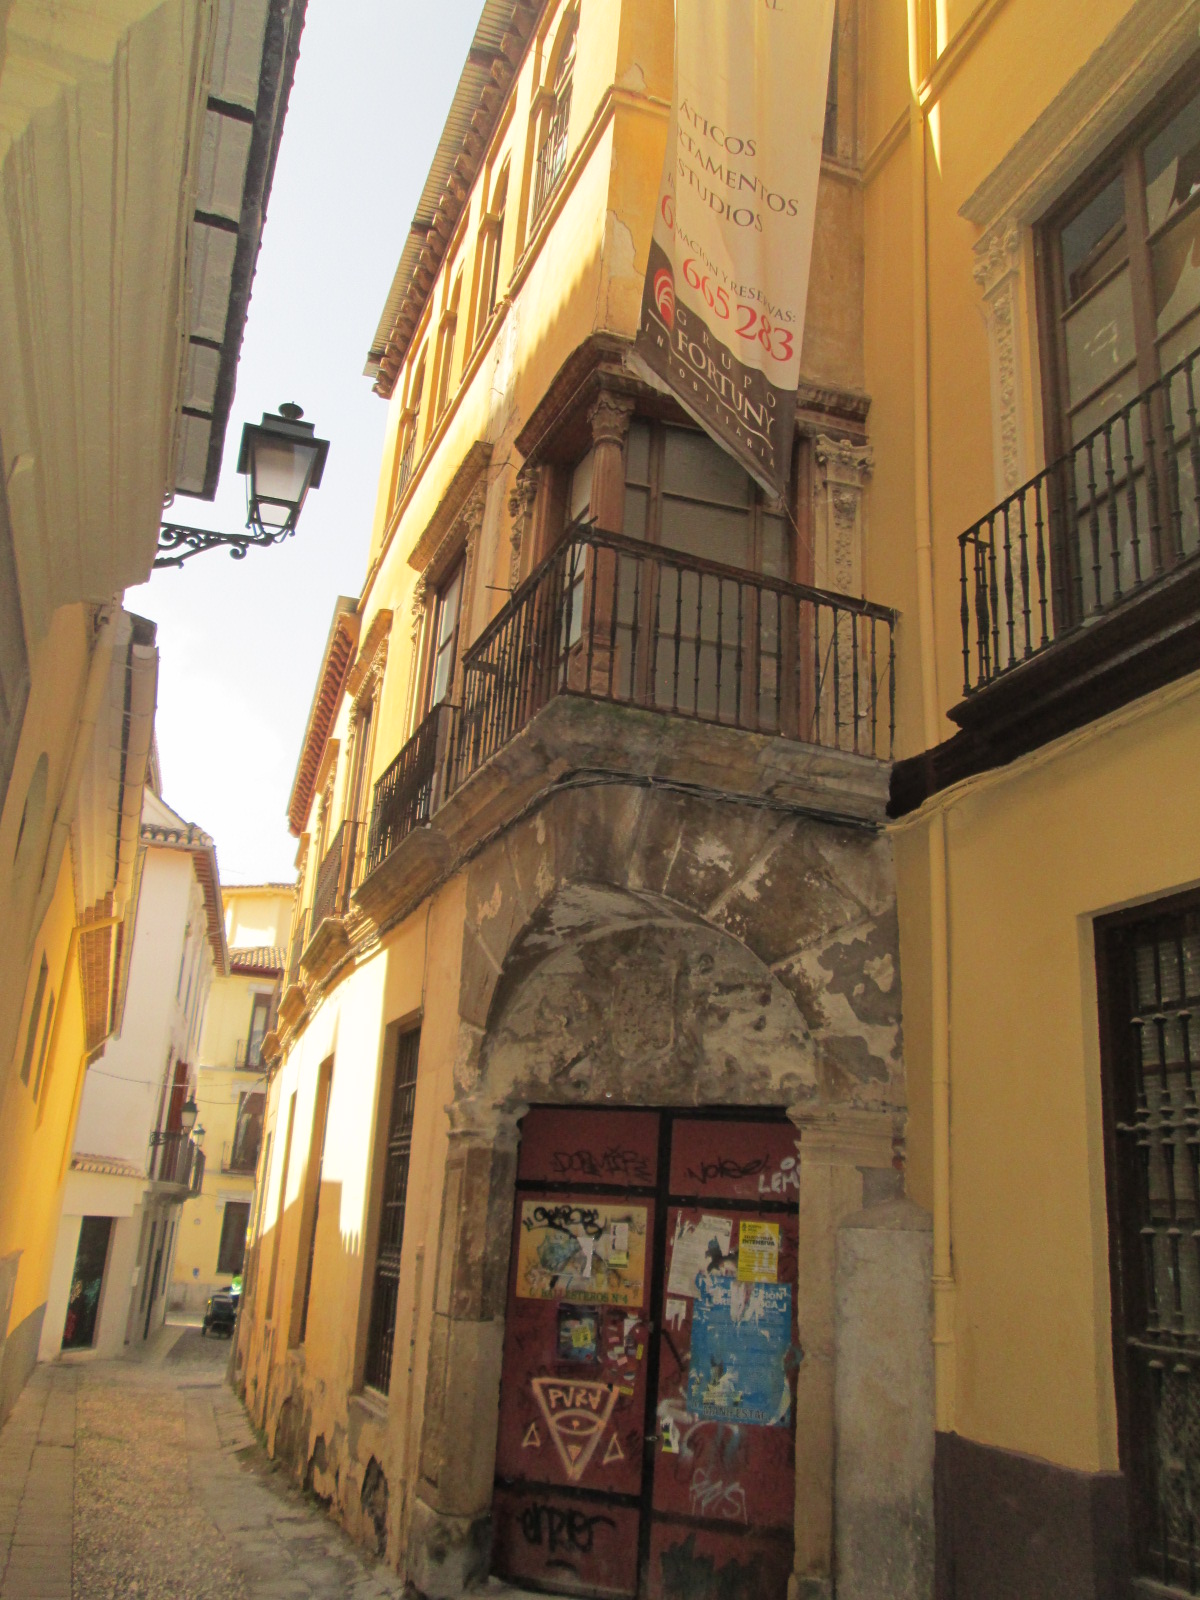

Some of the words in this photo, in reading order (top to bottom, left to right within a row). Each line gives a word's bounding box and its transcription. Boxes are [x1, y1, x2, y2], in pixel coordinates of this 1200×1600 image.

[682, 258, 730, 320] 665
[735, 304, 794, 362] 283
[677, 328, 776, 436] FORTUNY
